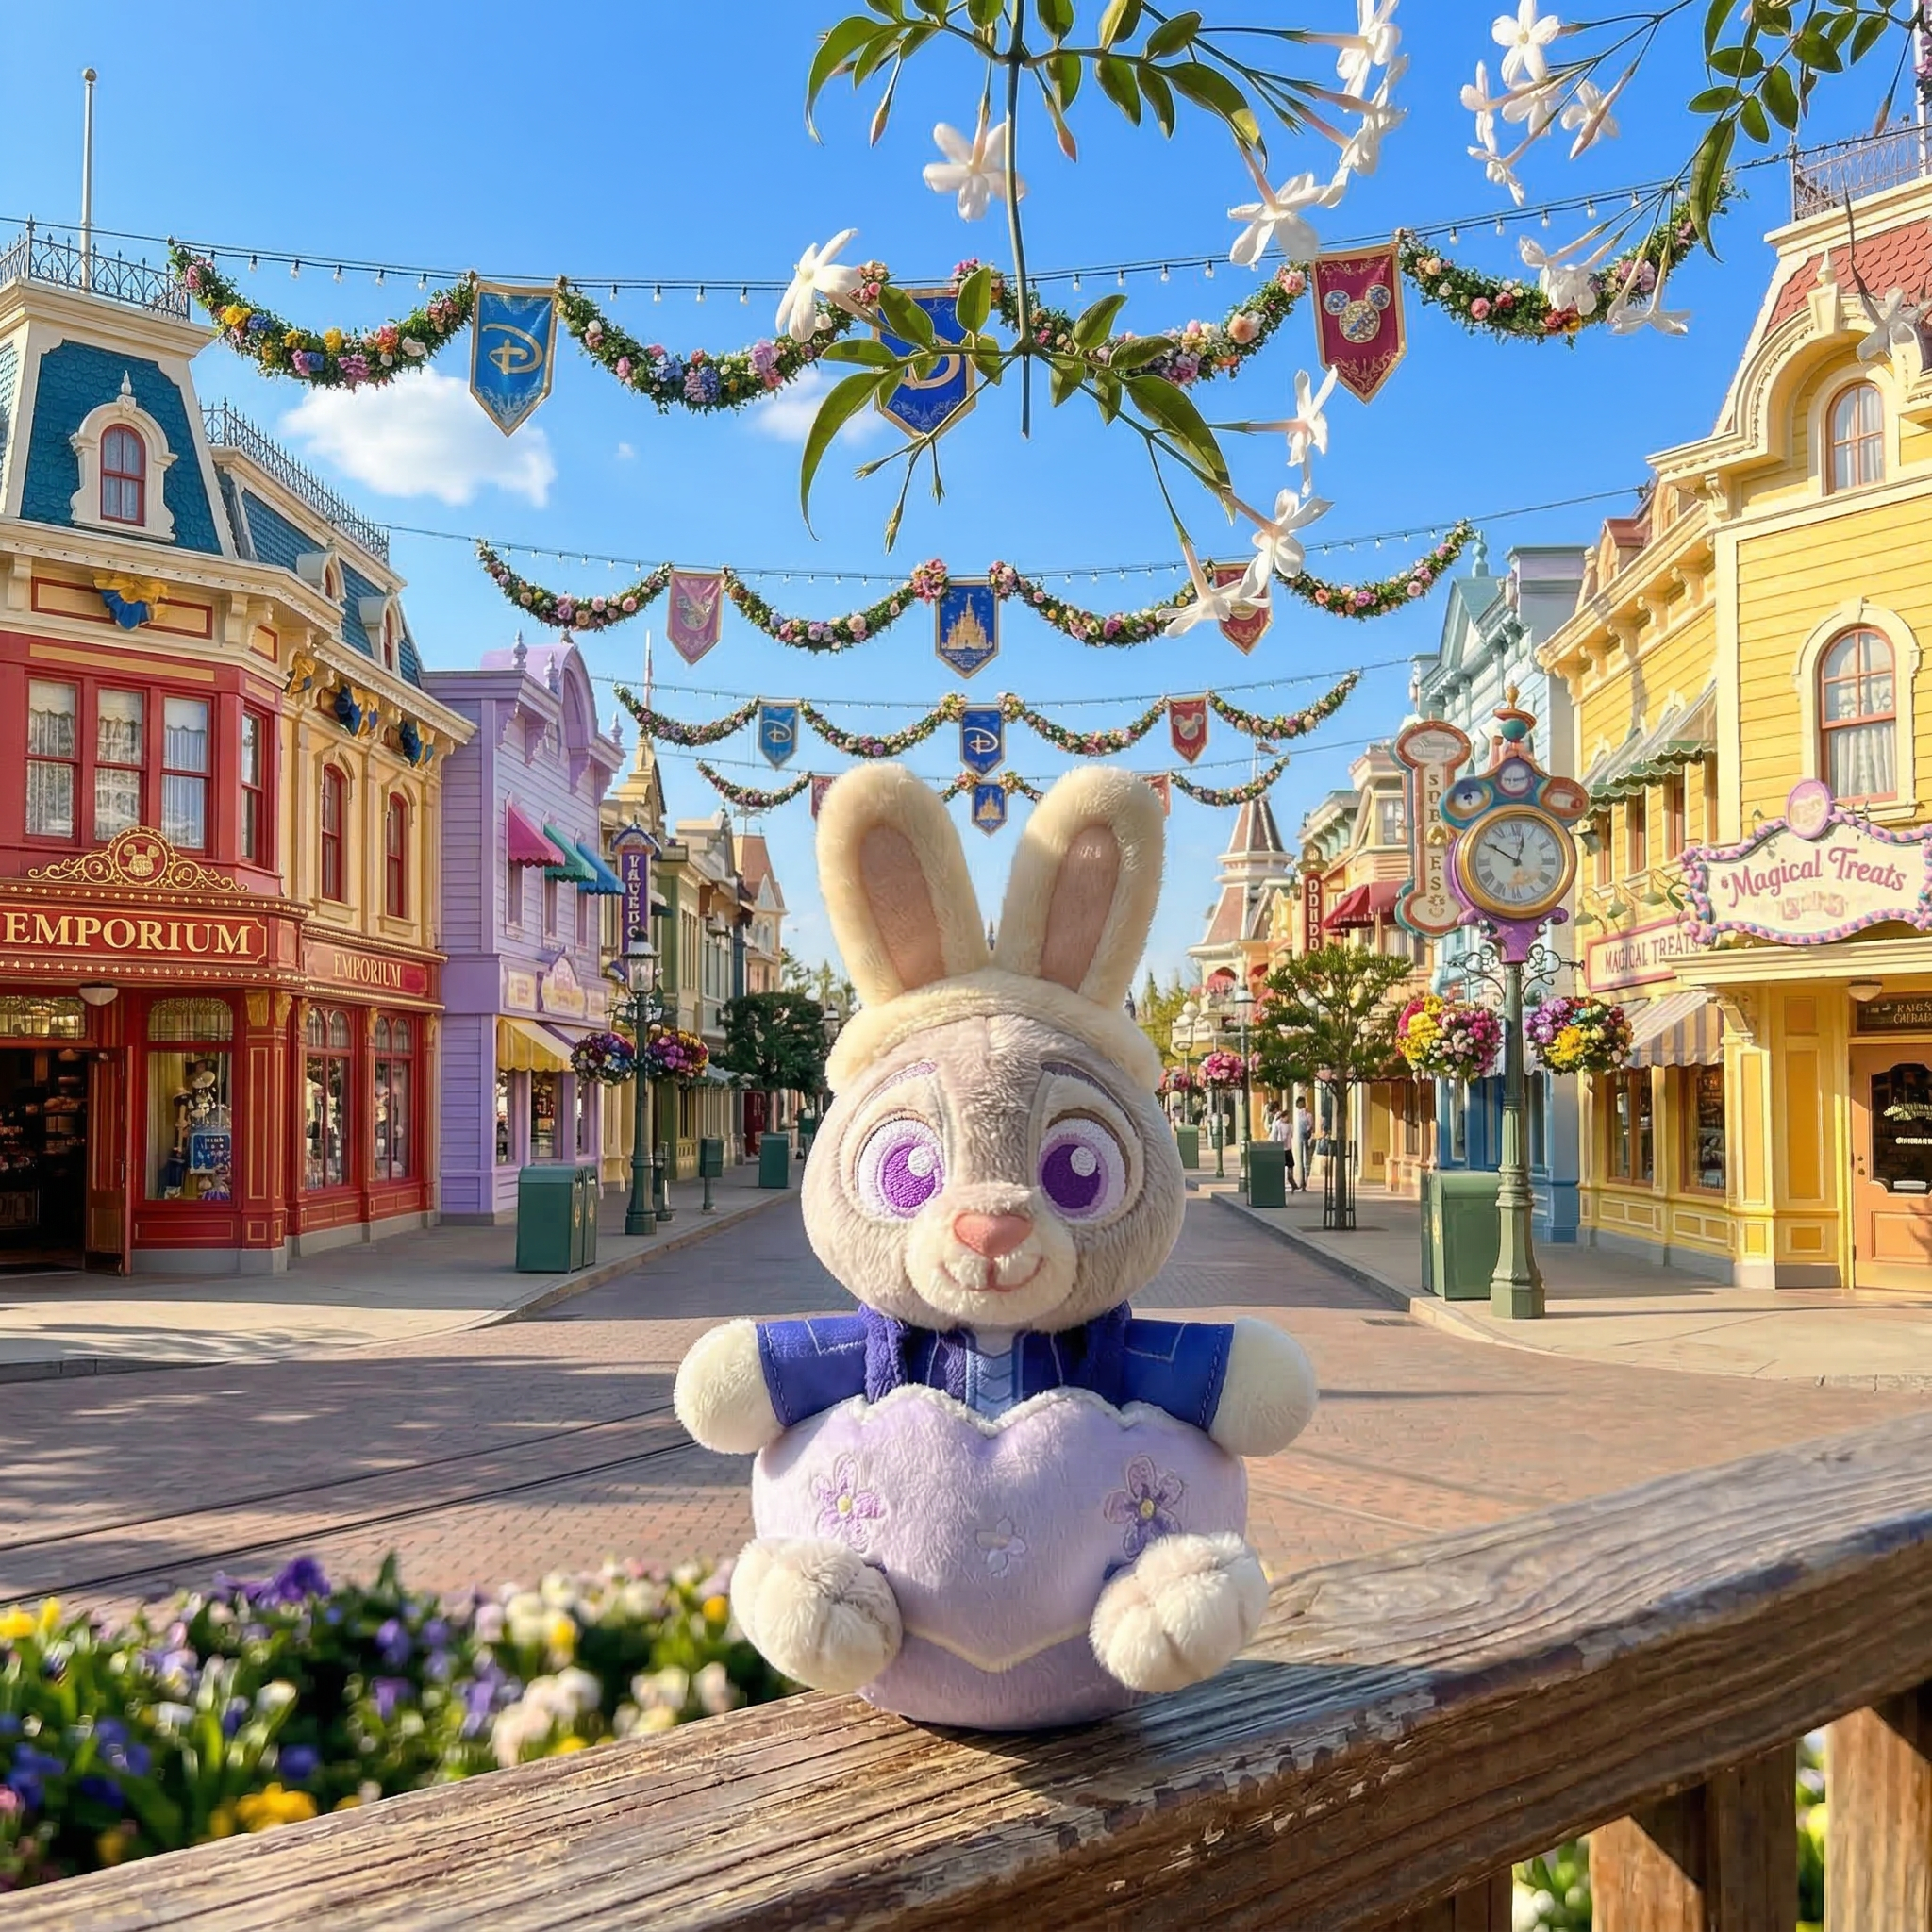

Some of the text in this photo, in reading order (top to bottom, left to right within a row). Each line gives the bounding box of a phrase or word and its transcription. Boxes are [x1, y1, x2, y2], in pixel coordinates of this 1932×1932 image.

[1728, 849, 1823, 908] Magical
[1828, 846, 1907, 891] Treats
[2, 912, 252, 955] EMPORIUM
[333, 953, 402, 988] EMPORIUM
